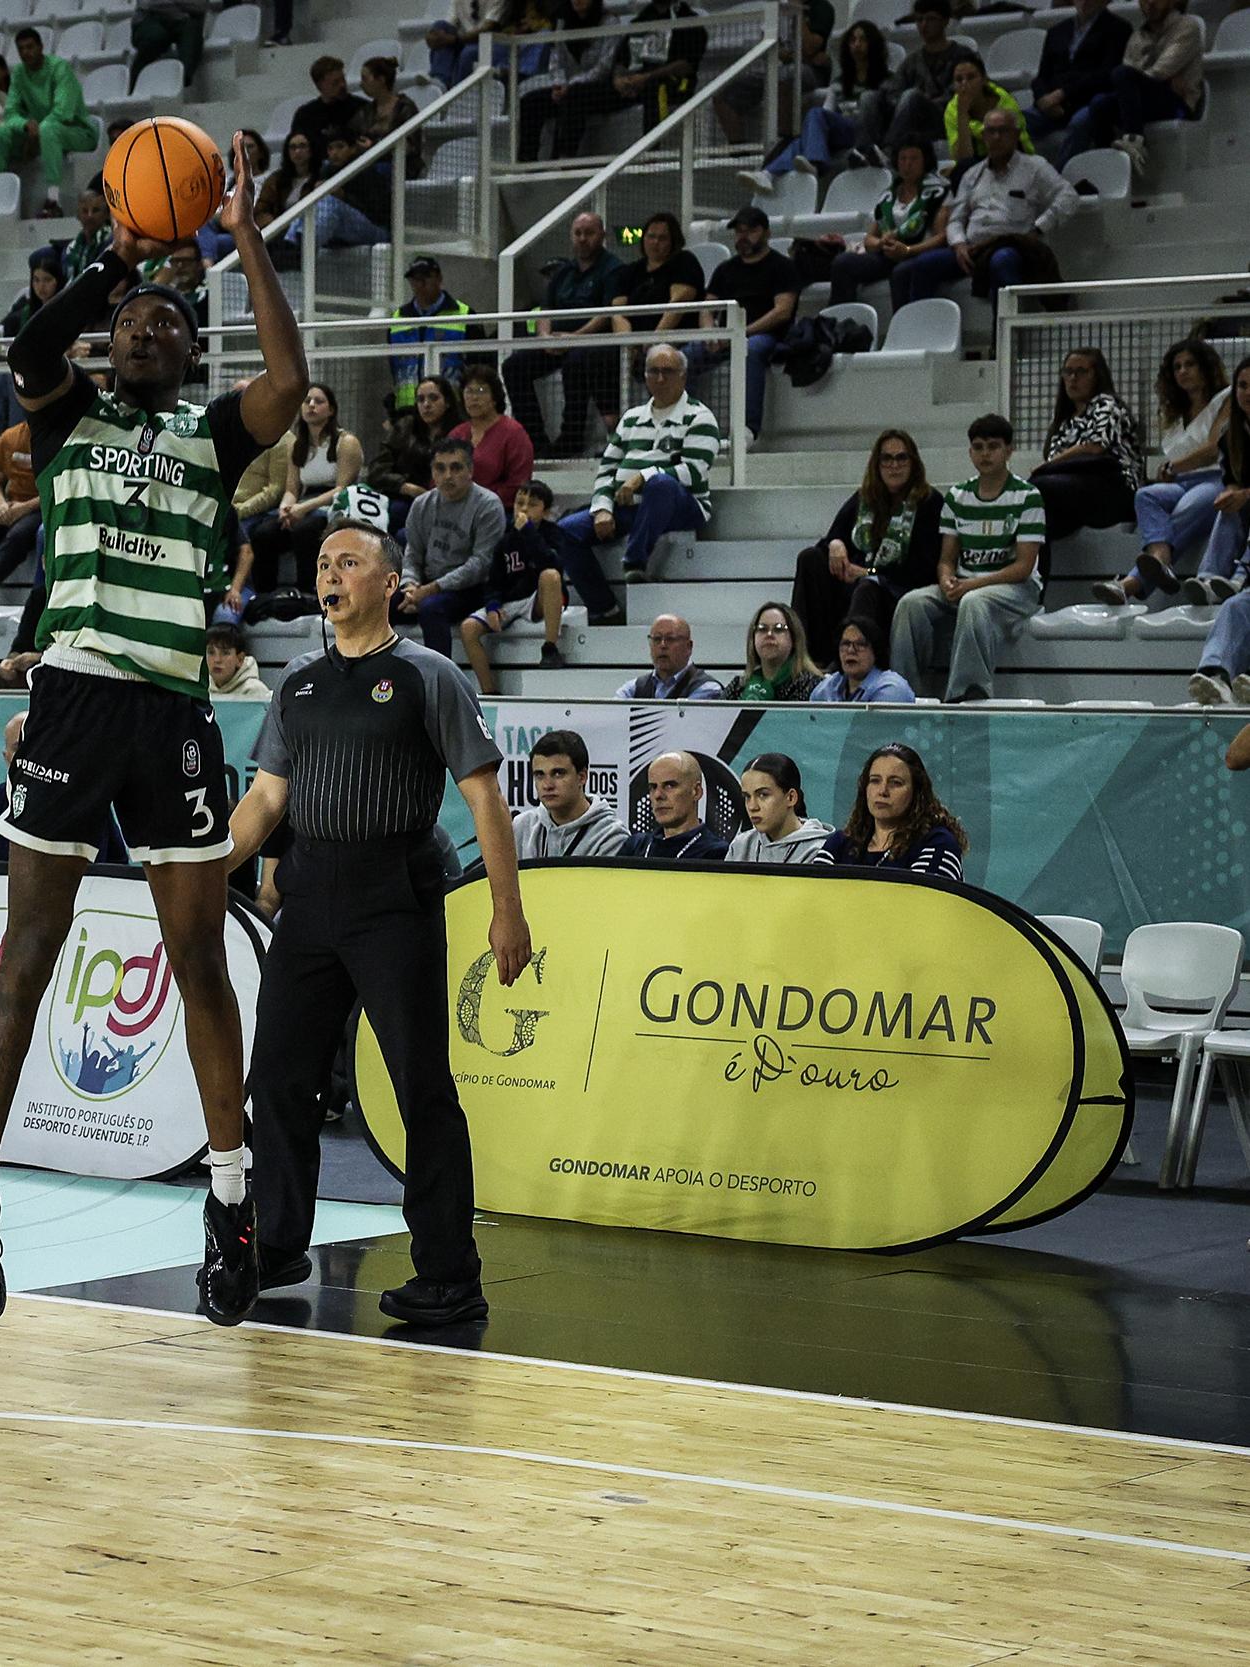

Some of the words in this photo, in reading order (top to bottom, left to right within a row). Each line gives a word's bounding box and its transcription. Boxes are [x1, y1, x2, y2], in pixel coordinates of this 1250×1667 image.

[90, 445, 185, 487] SPORTING
[123, 479, 150, 530] 3
[99, 527, 166, 562] Buildity.
[589, 772, 618, 795] DOS
[184, 786, 215, 839] 3
[640, 964, 997, 1045] GONDOMAR
[454, 1071, 479, 1085] CÍPIO
[482, 1075, 494, 1086] DE
[23, 1116, 71, 1135] DESPORTO
[71, 1124, 79, 1136] E
[78, 1126, 135, 1146] JUVENTUDE,
[136, 1133, 150, 1147] I.P.
[27, 1101, 77, 1120] INSTITUTO
[77, 1109, 136, 1129] PORTUGUÊS
[137, 1118, 154, 1131] DO
[549, 1157, 651, 1181] GONDOMAR
[653, 1167, 704, 1187] APOIA
[709, 1172, 723, 1188] O
[727, 1173, 817, 1197] DESPORTO
